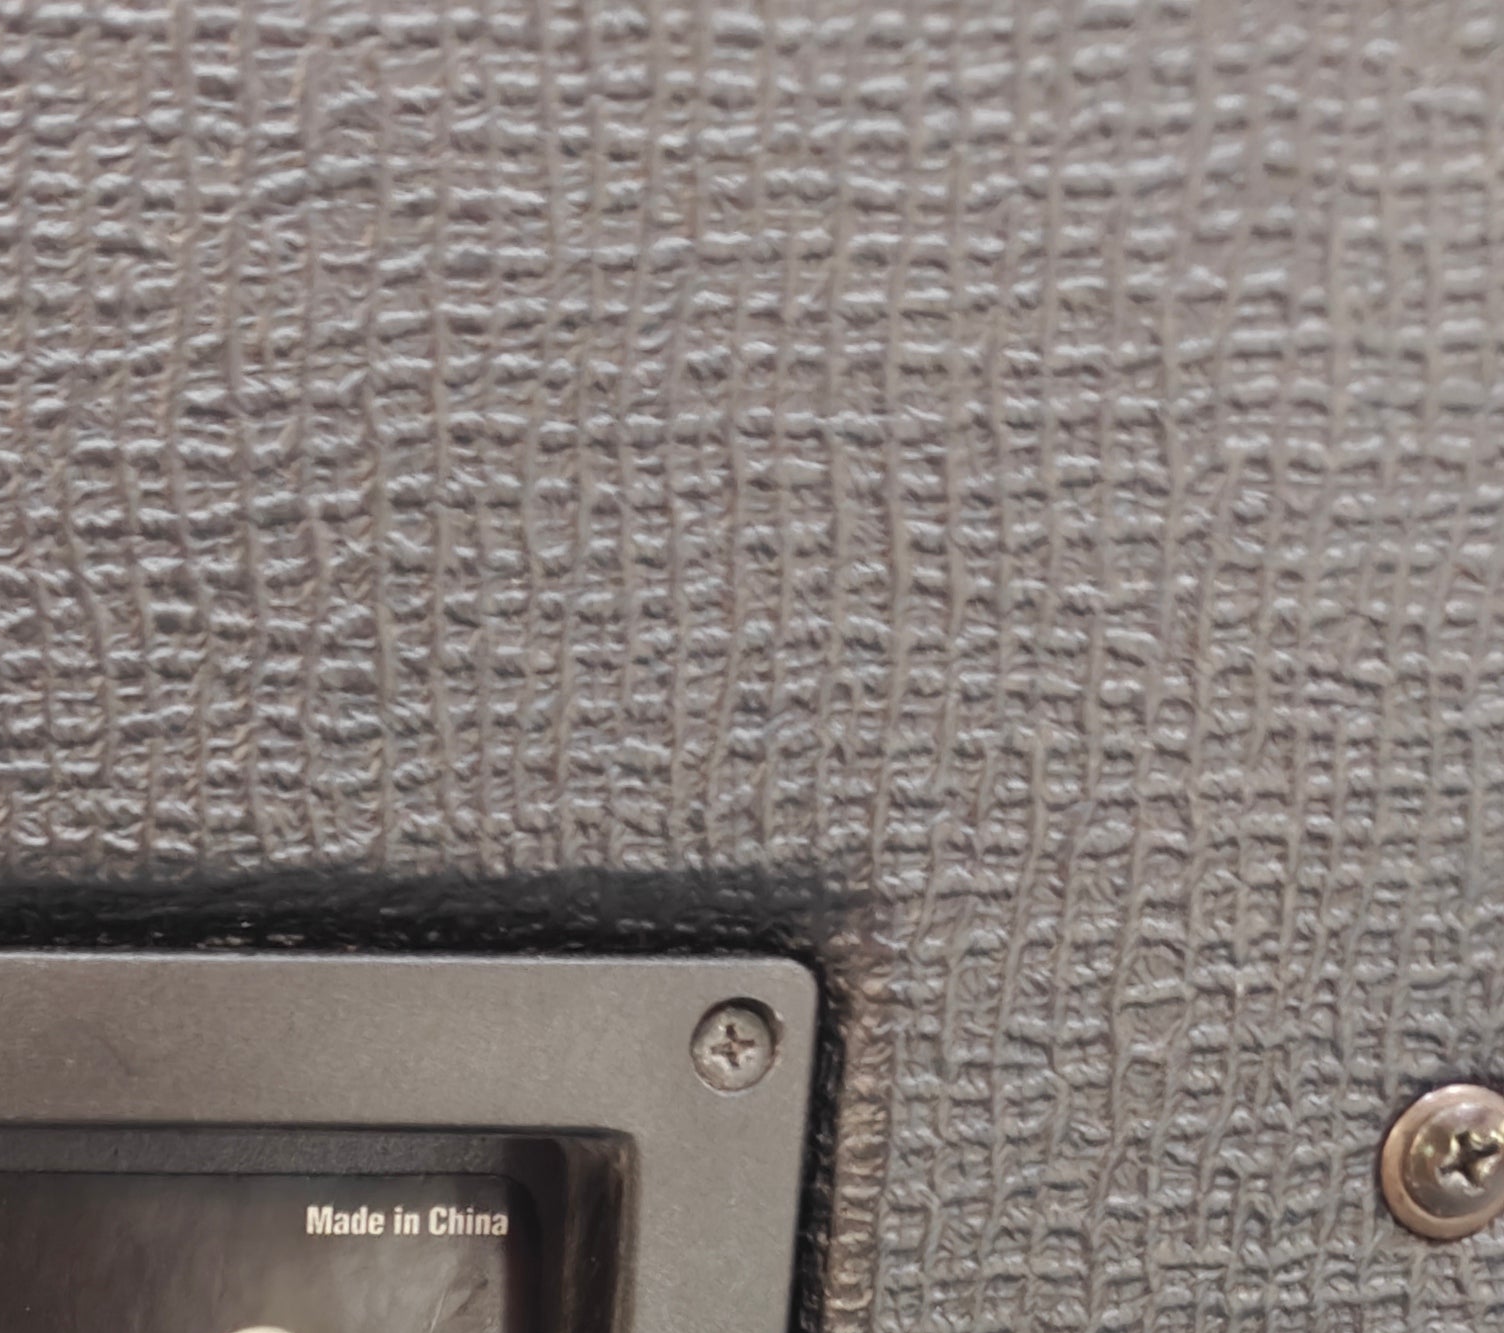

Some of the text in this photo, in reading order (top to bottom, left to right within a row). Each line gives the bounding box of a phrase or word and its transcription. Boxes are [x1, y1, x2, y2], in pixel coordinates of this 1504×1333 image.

[306, 1207, 509, 1237] Made in China
